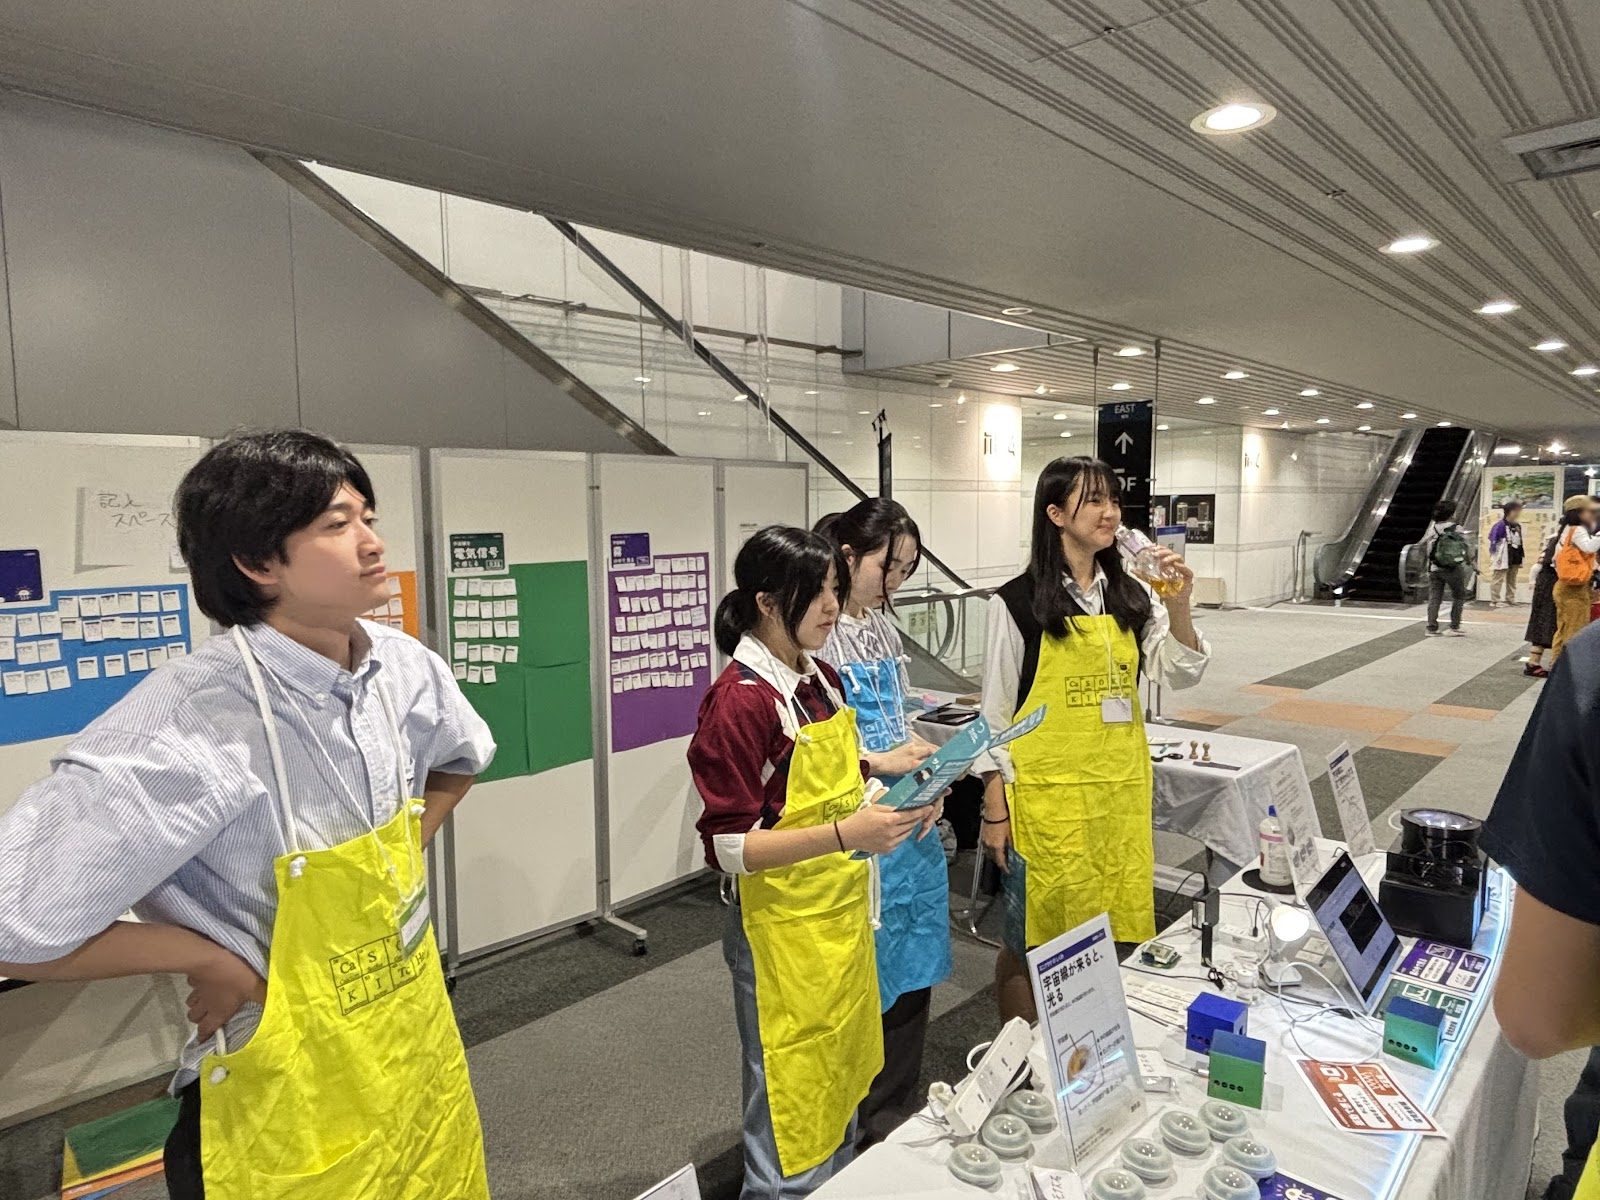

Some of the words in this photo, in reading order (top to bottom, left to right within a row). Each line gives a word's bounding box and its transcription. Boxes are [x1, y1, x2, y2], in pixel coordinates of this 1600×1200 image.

[1114, 403, 1136, 414] EAST
[97, 493, 143, 509] 記入
[111, 511, 178, 528] スペース
[453, 546, 499, 560] 電気信号
[340, 961, 356, 974] Ca
[367, 951, 377, 963] S
[1042, 948, 1104, 992] 宇宙線が来ると、
[347, 988, 357, 1003] K
[375, 977, 382, 989] I
[1046, 987, 1064, 1009] 光る
